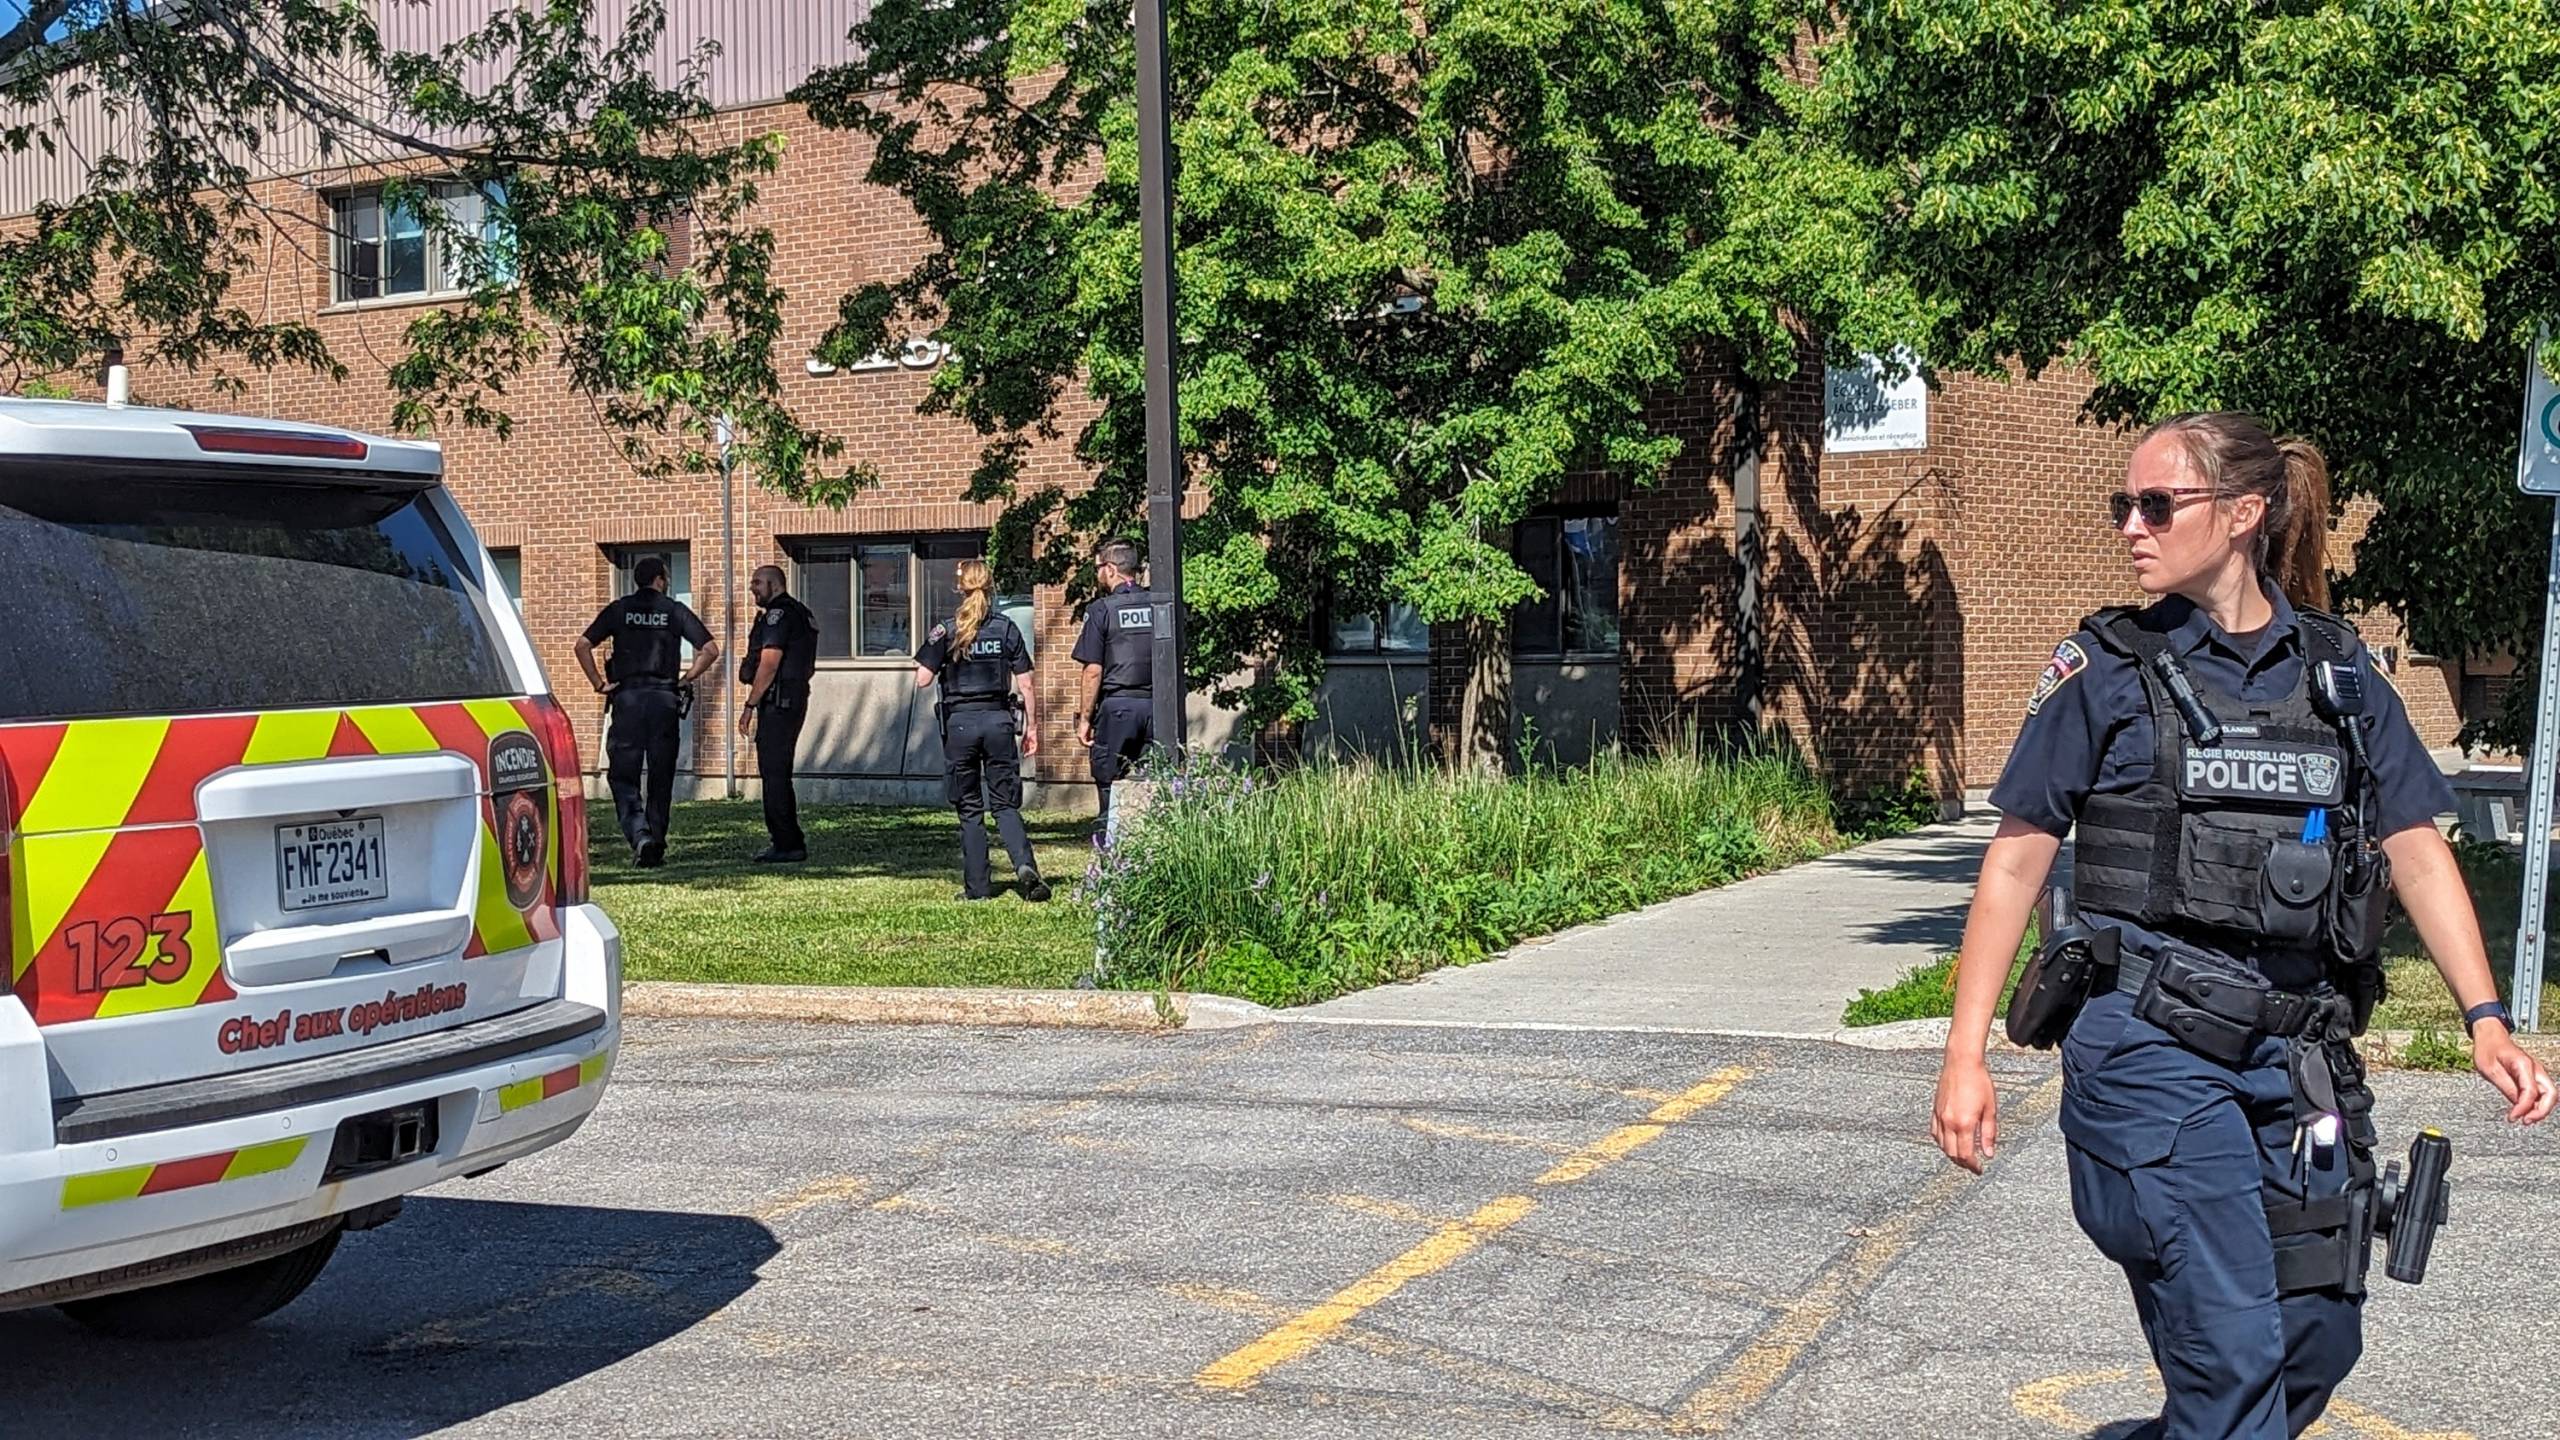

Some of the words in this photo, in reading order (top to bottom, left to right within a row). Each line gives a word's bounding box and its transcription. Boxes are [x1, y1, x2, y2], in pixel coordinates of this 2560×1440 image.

[626, 612, 669, 625] POLICE
[1121, 611, 1152, 625] POLI
[968, 641, 1002, 655] OLICE
[495, 747, 538, 773] INCENDIE
[2224, 749, 2296, 763] ROUSSILLON
[2186, 760, 2298, 793] POLICE
[319, 826, 355, 841] Québec
[283, 837, 380, 890] FMF2341
[307, 893, 316, 903] Je
[318, 893, 329, 901] me
[331, 888, 365, 900] souviens
[64, 910, 193, 994] 123
[217, 1009, 291, 1054] Chef
[294, 1007, 347, 1043] aux
[348, 981, 467, 1036] opérations
